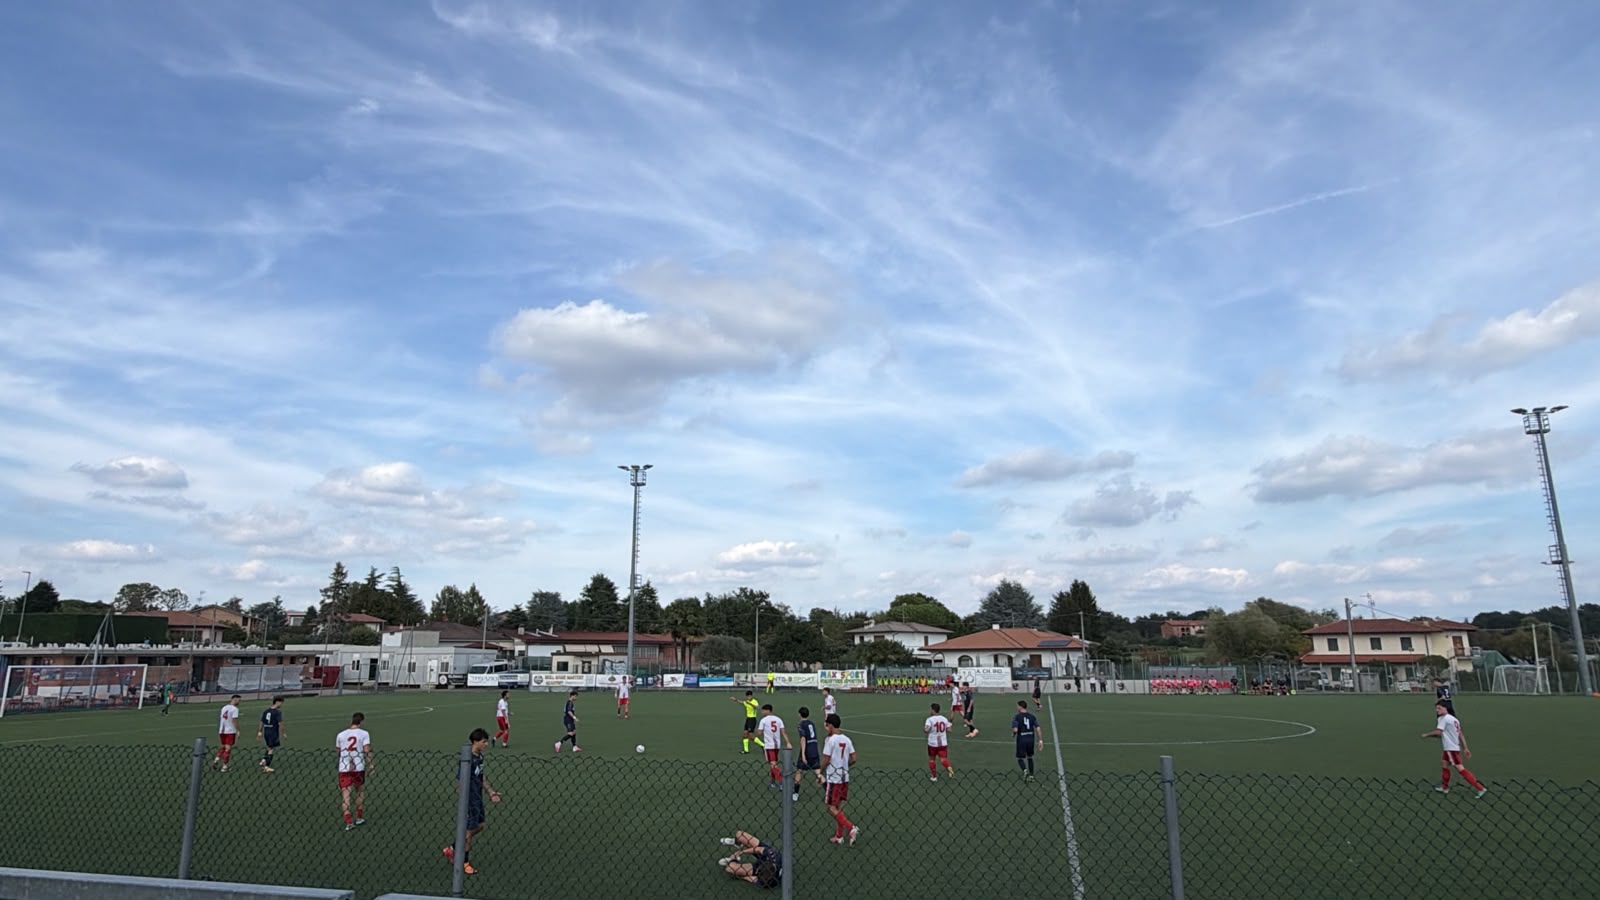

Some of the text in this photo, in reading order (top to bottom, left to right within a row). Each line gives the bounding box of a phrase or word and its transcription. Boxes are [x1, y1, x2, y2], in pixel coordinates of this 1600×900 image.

[222, 710, 228, 720] 4
[266, 712, 272, 724] 9
[770, 720, 777, 732] 5
[934, 721, 946, 733] 10
[1024, 717, 1030, 729] 4
[347, 736, 357, 751] 2
[839, 742, 847, 759] 7
